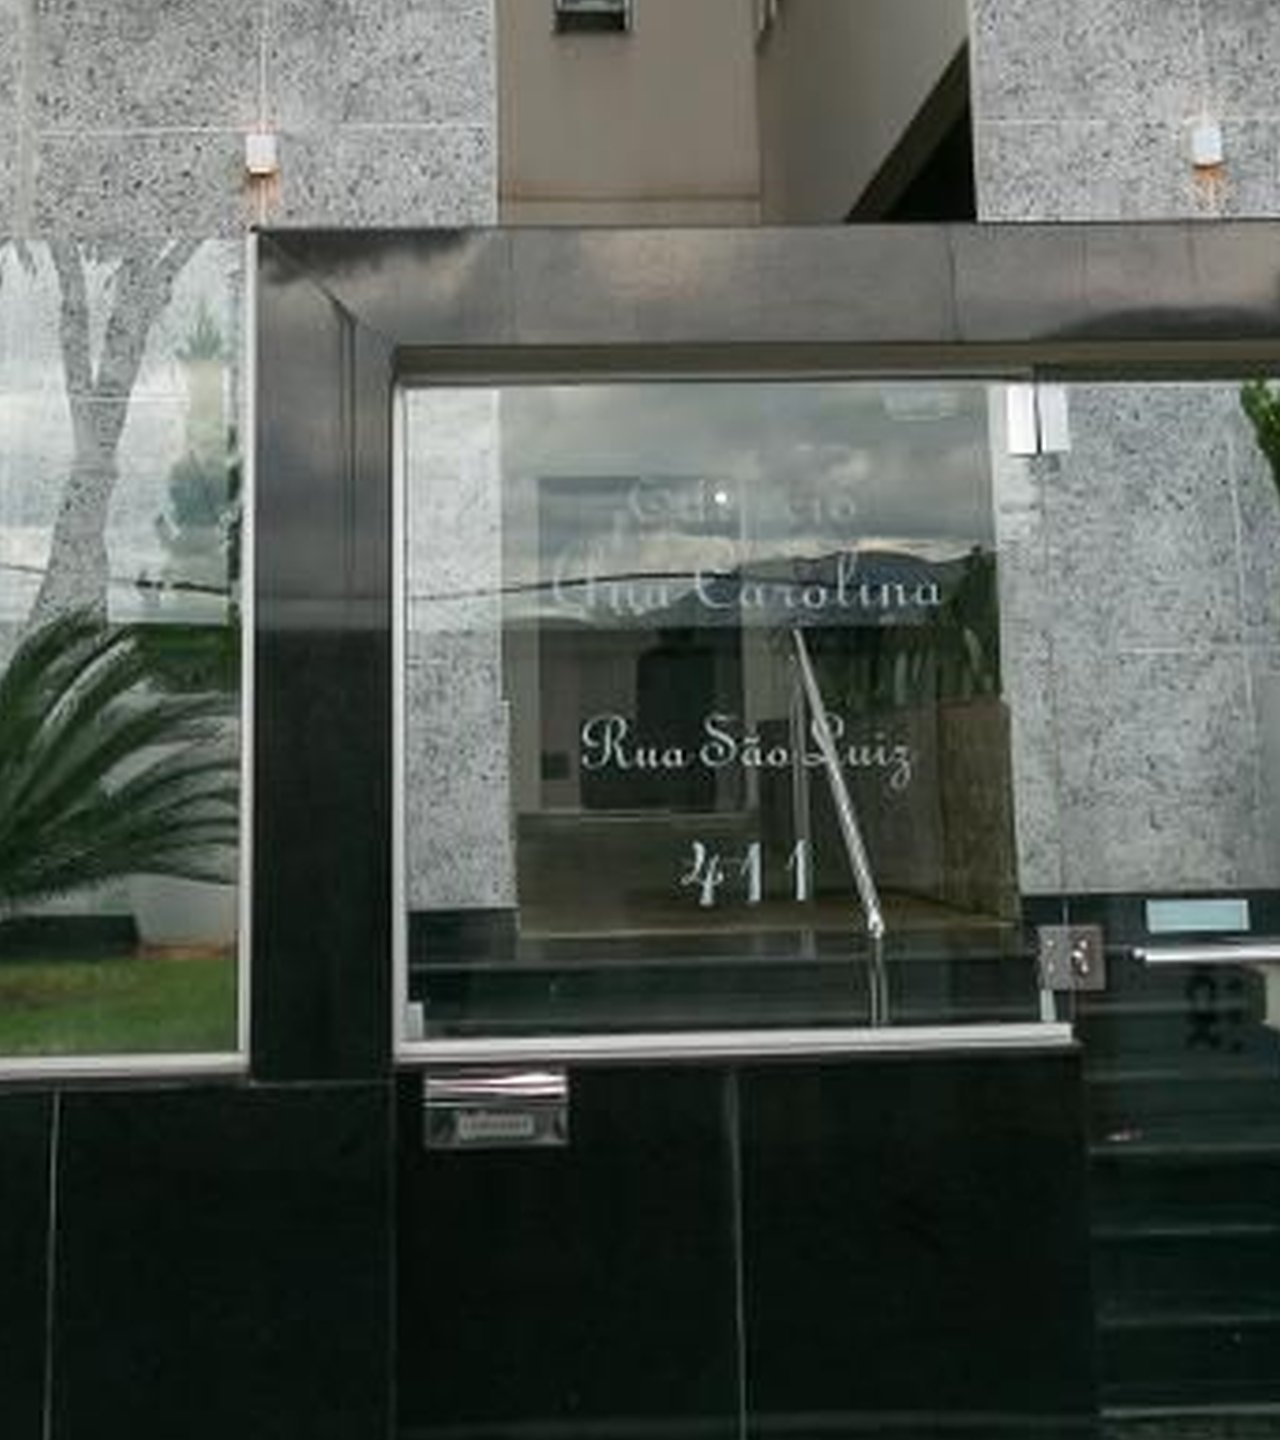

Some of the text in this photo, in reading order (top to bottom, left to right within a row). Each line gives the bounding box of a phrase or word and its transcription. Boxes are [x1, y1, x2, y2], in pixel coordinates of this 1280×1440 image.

[581, 712, 912, 790] Rua São Luiz
[681, 838, 808, 906] 411
